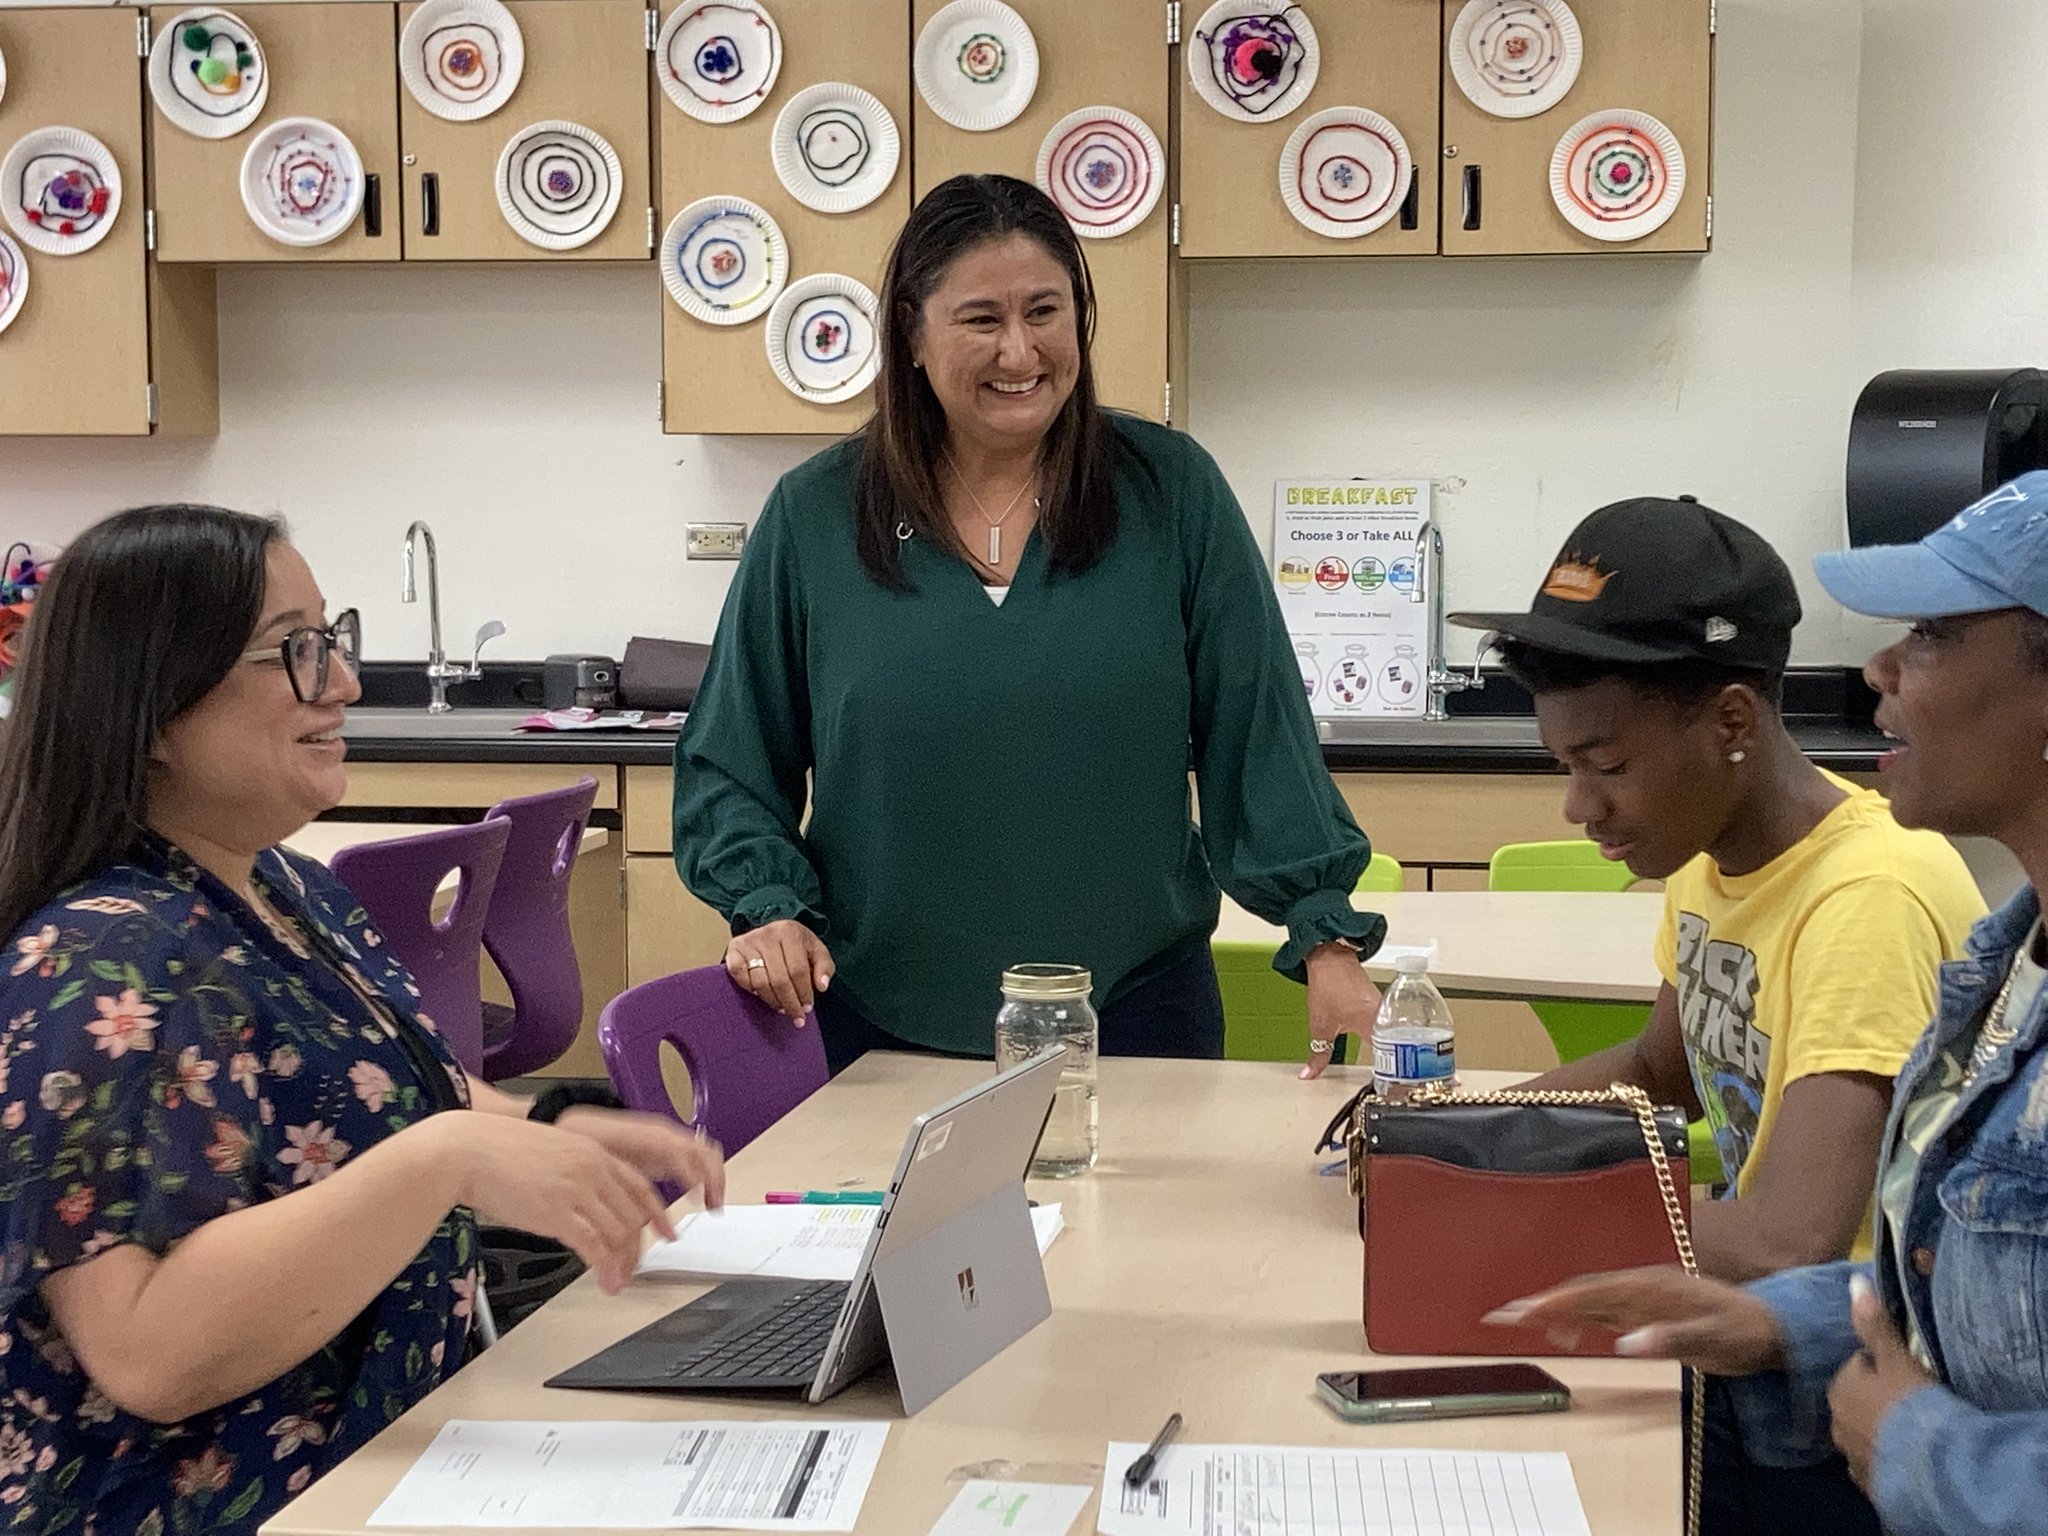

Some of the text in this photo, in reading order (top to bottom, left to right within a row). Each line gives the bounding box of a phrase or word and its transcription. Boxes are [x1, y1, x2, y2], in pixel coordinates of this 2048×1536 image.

[1287, 487, 1417, 505] BREAKFAST
[1290, 530, 1414, 541] Choose 3 or Take ALL
